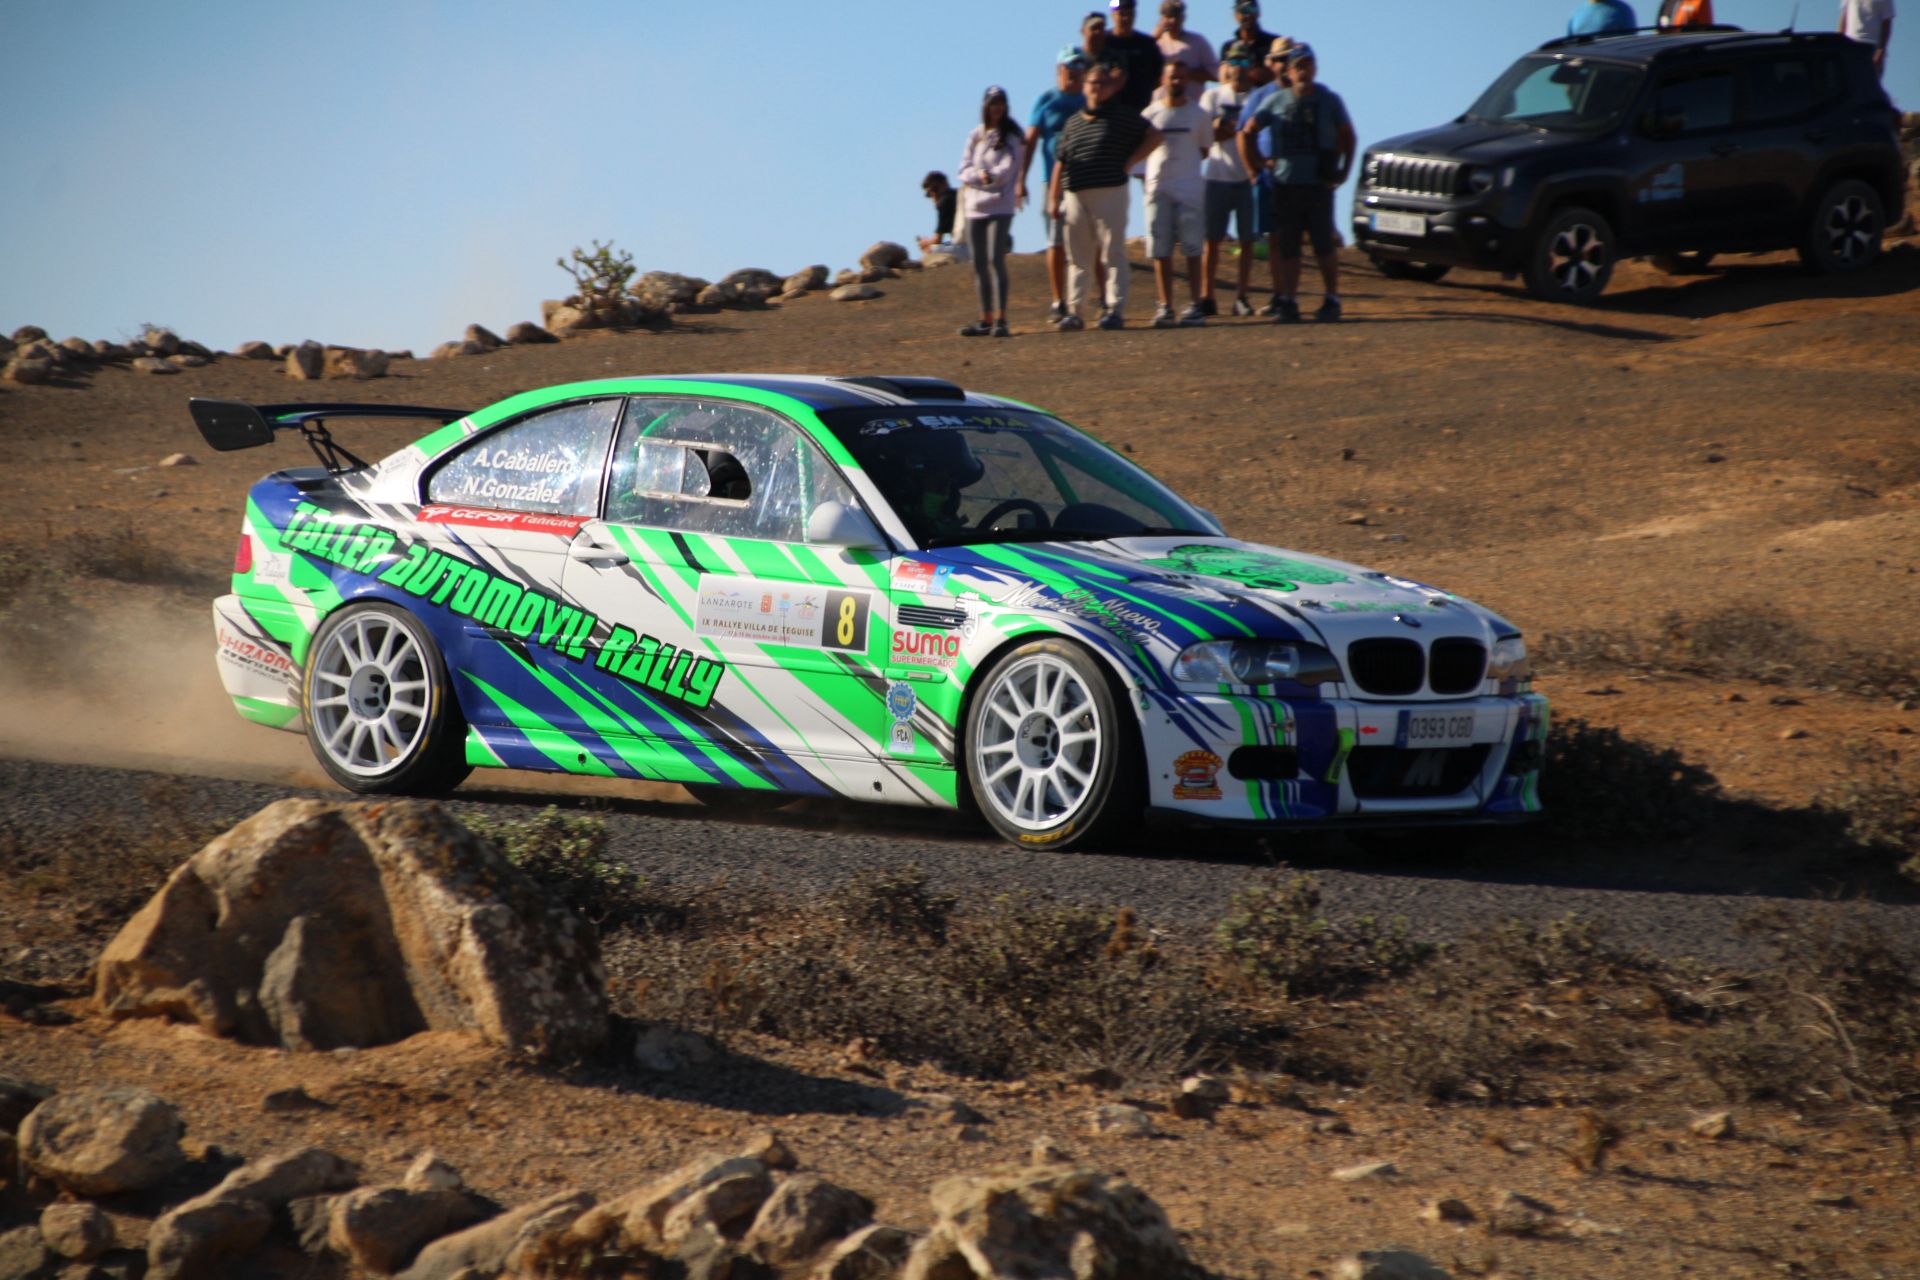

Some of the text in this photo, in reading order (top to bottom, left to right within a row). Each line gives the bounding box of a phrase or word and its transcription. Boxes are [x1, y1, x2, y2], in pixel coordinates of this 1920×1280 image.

[279, 501, 397, 576] TALLER
[377, 543, 598, 664] AUTOMOVIL
[595, 623, 726, 711] RALLY
[701, 597, 753, 610] LANZAROTE
[702, 618, 711, 626] IX
[713, 619, 742, 630] RALLYE
[744, 622, 767, 632] VILLA
[768, 625, 779, 633] DE
[782, 626, 815, 638] TEGUISE
[837, 596, 856, 646] 8
[1410, 717, 1446, 739] 0393
